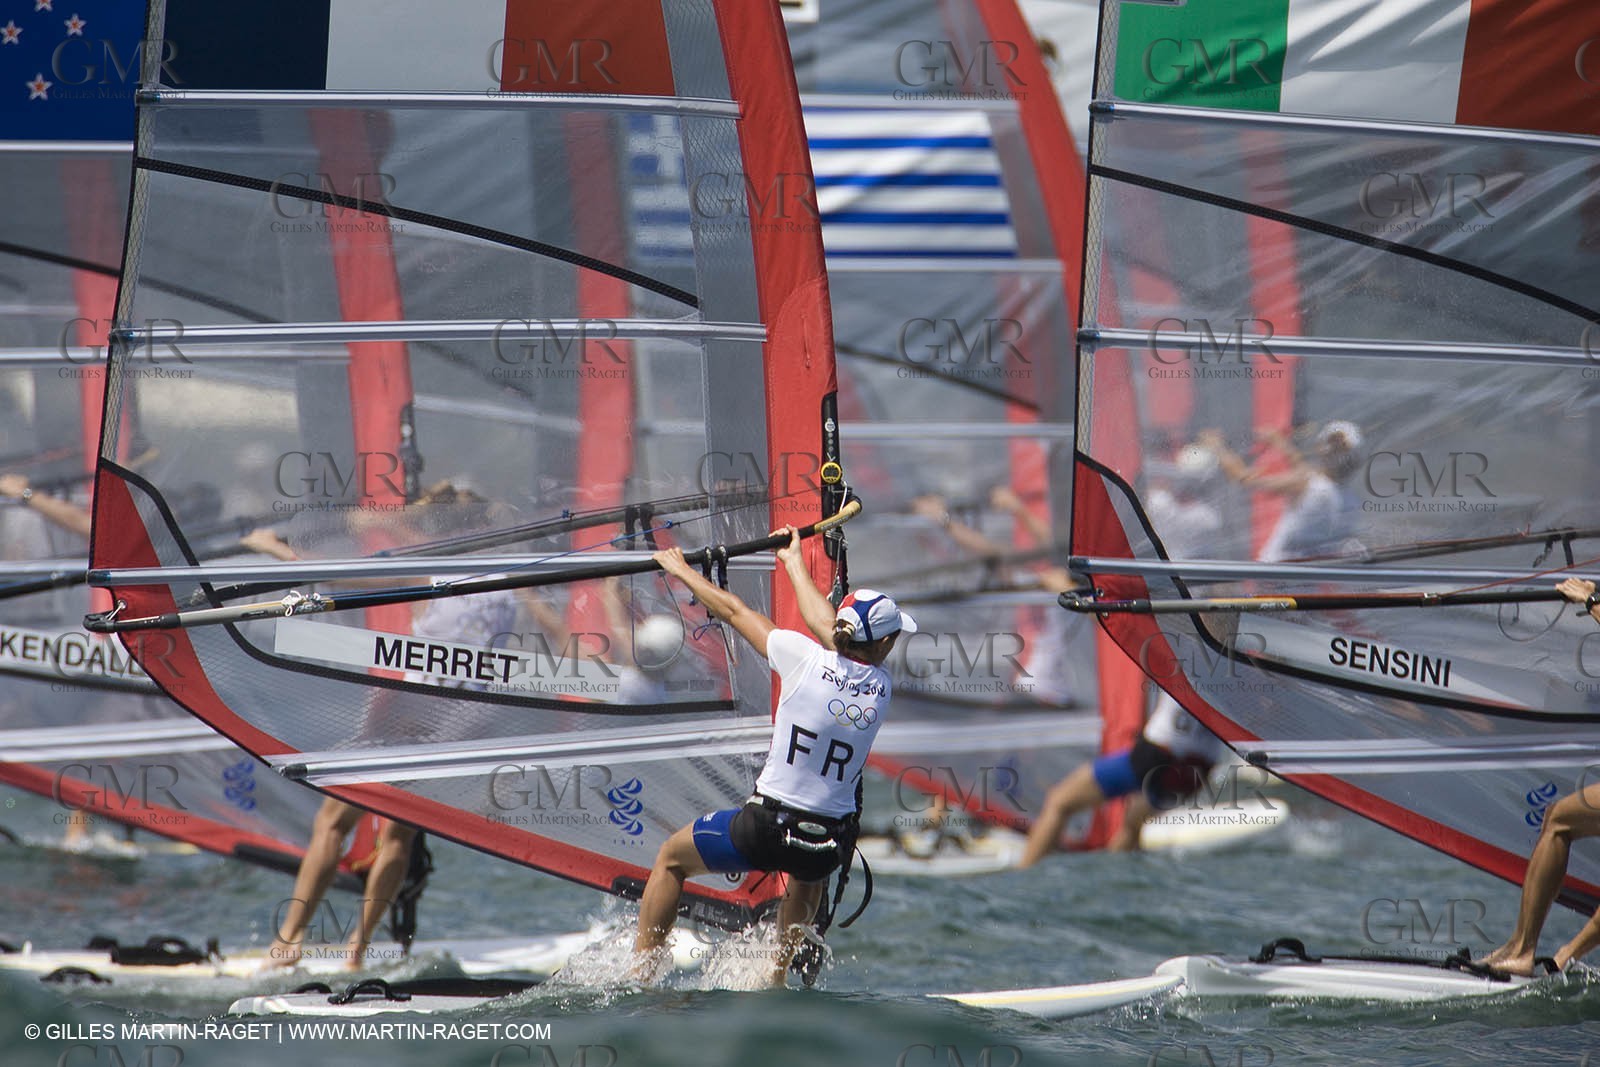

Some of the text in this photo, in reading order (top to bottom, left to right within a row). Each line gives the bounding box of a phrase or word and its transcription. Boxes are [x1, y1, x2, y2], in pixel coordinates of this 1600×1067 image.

[374, 637, 519, 683] MERRET
[822, 666, 860, 697] Beijing
[1328, 637, 1451, 688] SENSINI
